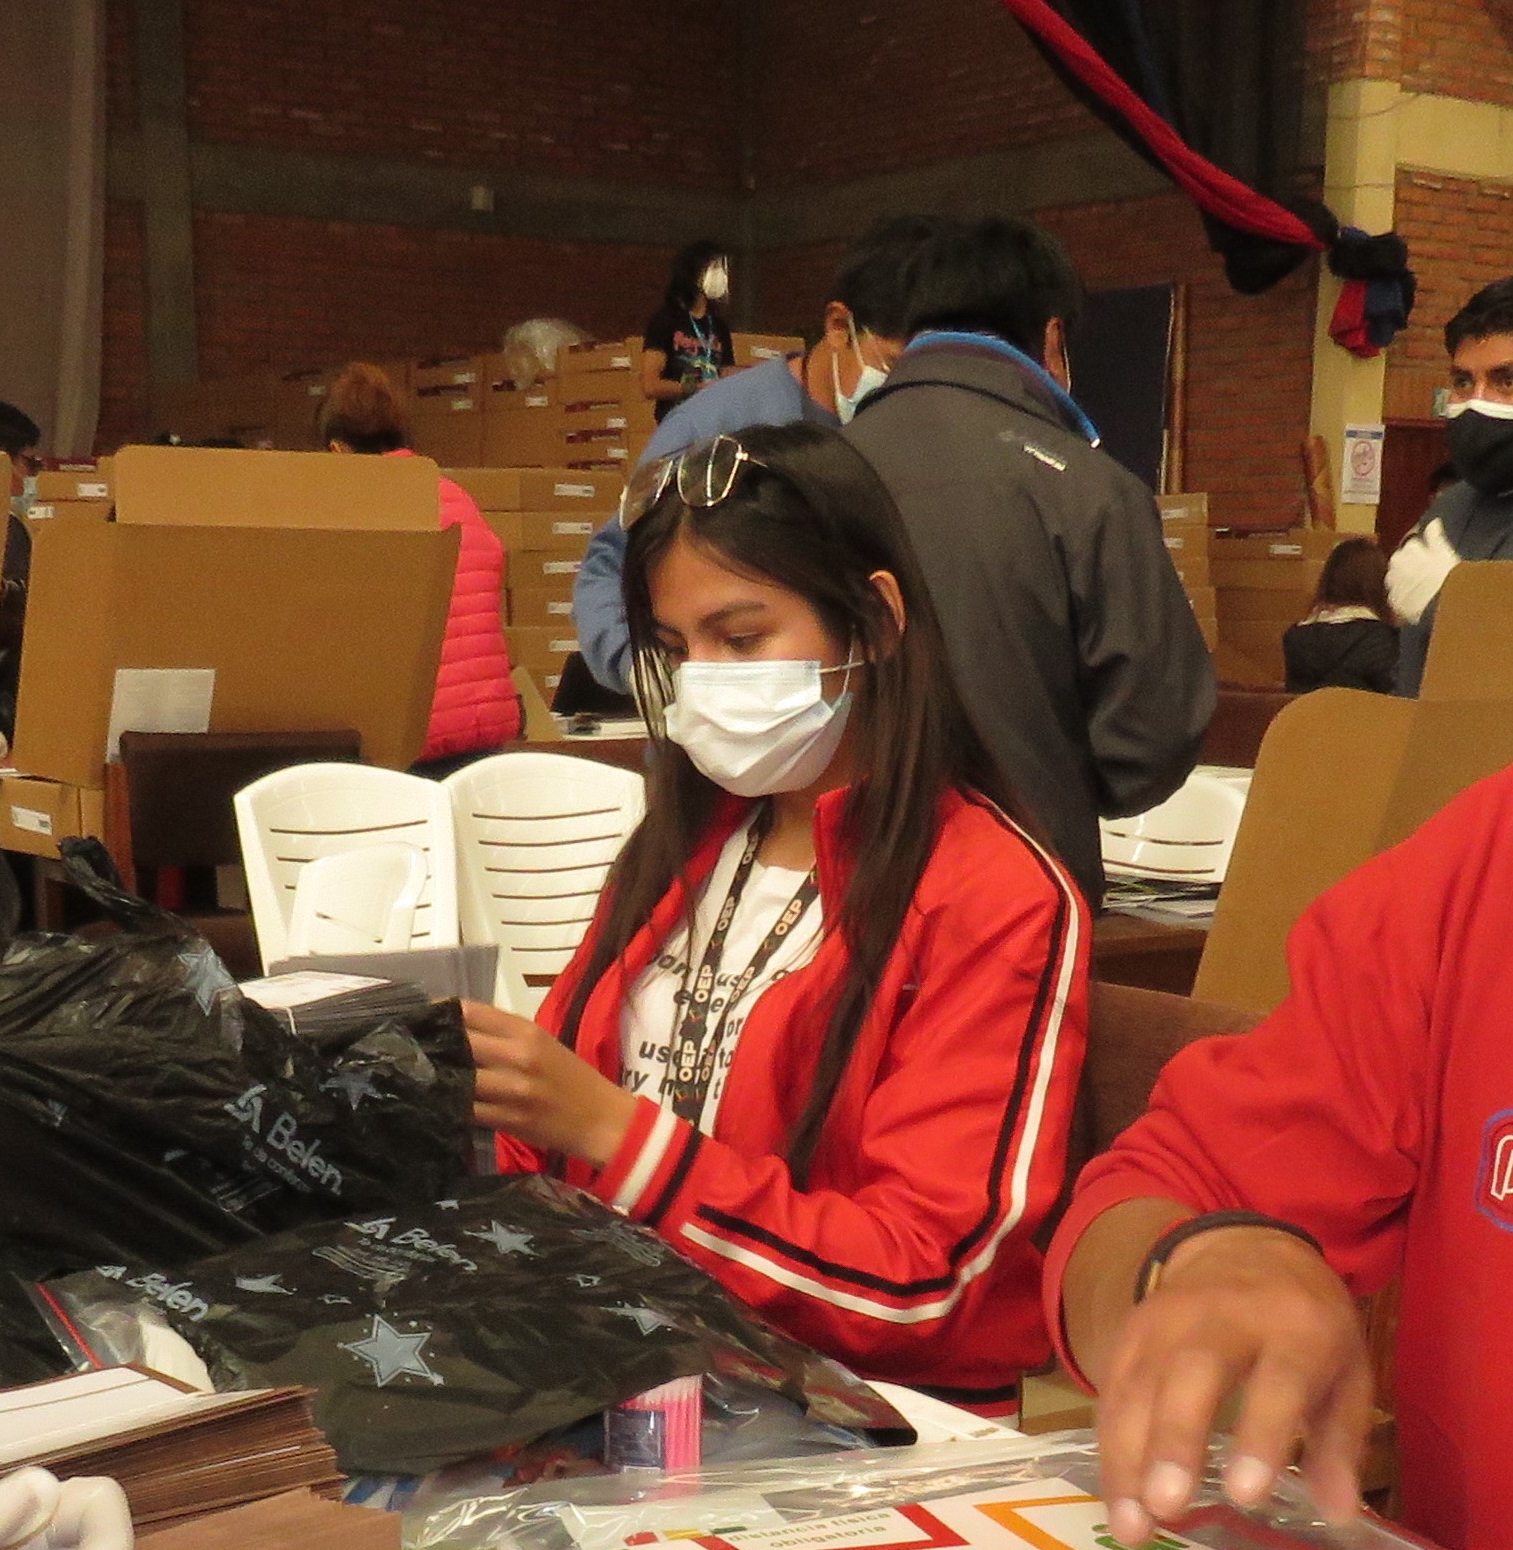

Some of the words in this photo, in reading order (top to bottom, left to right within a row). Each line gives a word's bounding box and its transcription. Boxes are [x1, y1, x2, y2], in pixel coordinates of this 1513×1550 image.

[774, 898, 802, 936] OEP
[694, 963, 714, 1003] OEP
[678, 1038, 697, 1082] OEP
[266, 1111, 343, 1196] Belen
[125, 1272, 209, 1322] Belen
[769, 1524, 887, 1549] obligatoria
